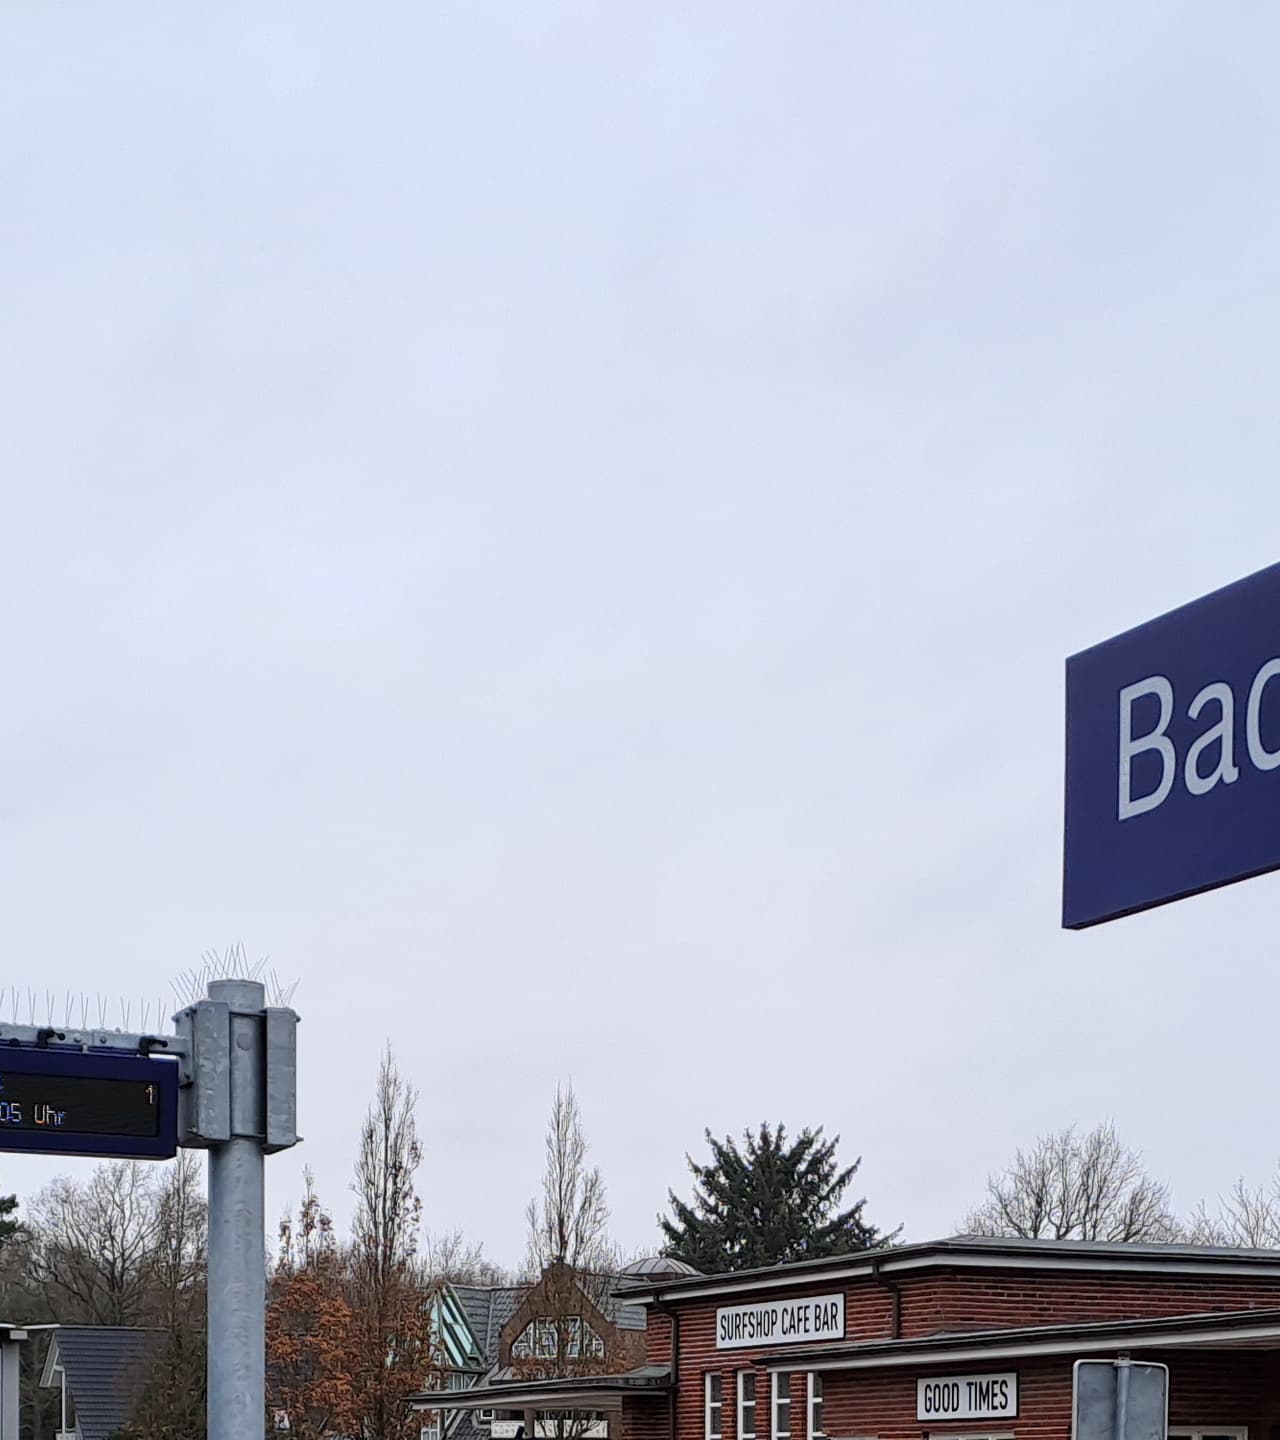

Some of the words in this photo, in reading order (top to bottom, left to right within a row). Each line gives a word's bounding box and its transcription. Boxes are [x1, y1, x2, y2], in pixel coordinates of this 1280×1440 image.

[145, 1084, 155, 1105] 1
[33, 1104, 67, 1127] Uhr
[720, 1308, 778, 1341] SURFSHOP
[781, 1304, 811, 1336] CAFE
[814, 1302, 839, 1333] BAR
[924, 1382, 960, 1414] GOOD
[966, 1379, 1009, 1411] TIMES
